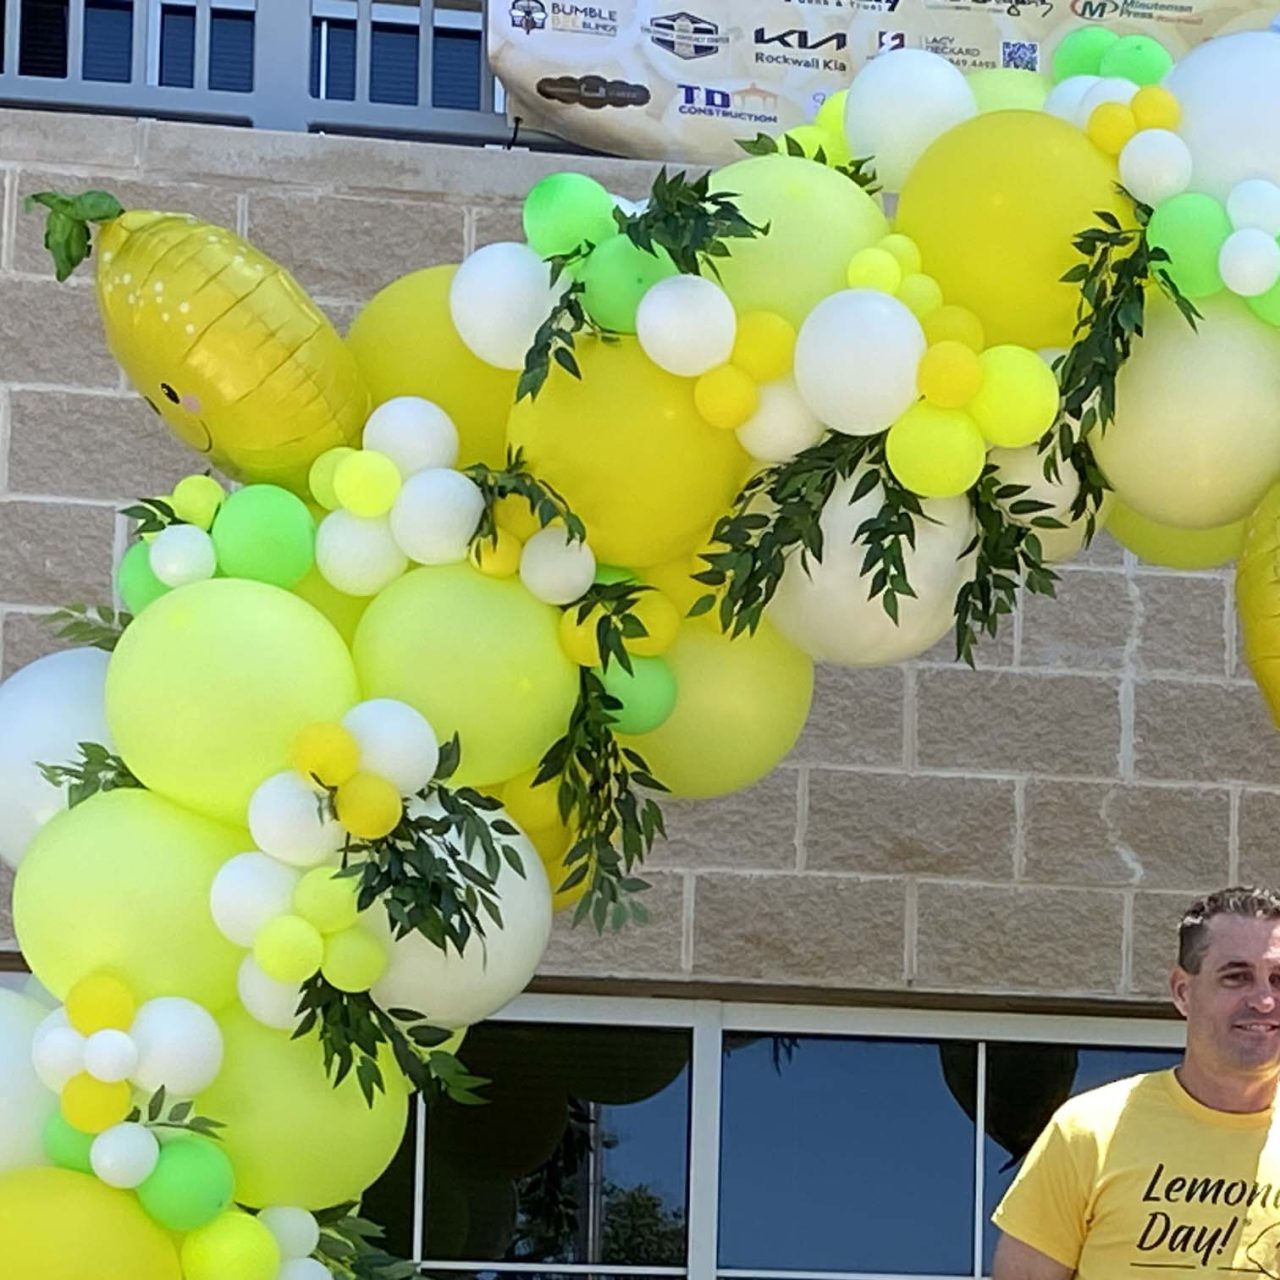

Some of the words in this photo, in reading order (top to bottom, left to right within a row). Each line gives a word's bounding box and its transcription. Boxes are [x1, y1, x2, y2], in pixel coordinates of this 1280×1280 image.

[551, 2, 617, 22] BUMBLE
[1119, 8, 1154, 20] Press
[1121, 0, 1193, 13] Minuteman
[925, 36, 955, 45] LACY
[925, 45, 981, 57] DECKARD
[754, 51, 820, 69] Rockwall
[822, 58, 847, 72] Kia
[677, 83, 731, 109] TD
[678, 105, 778, 123] CONSTRUCTION
[1136, 1211, 1239, 1267] Day!
